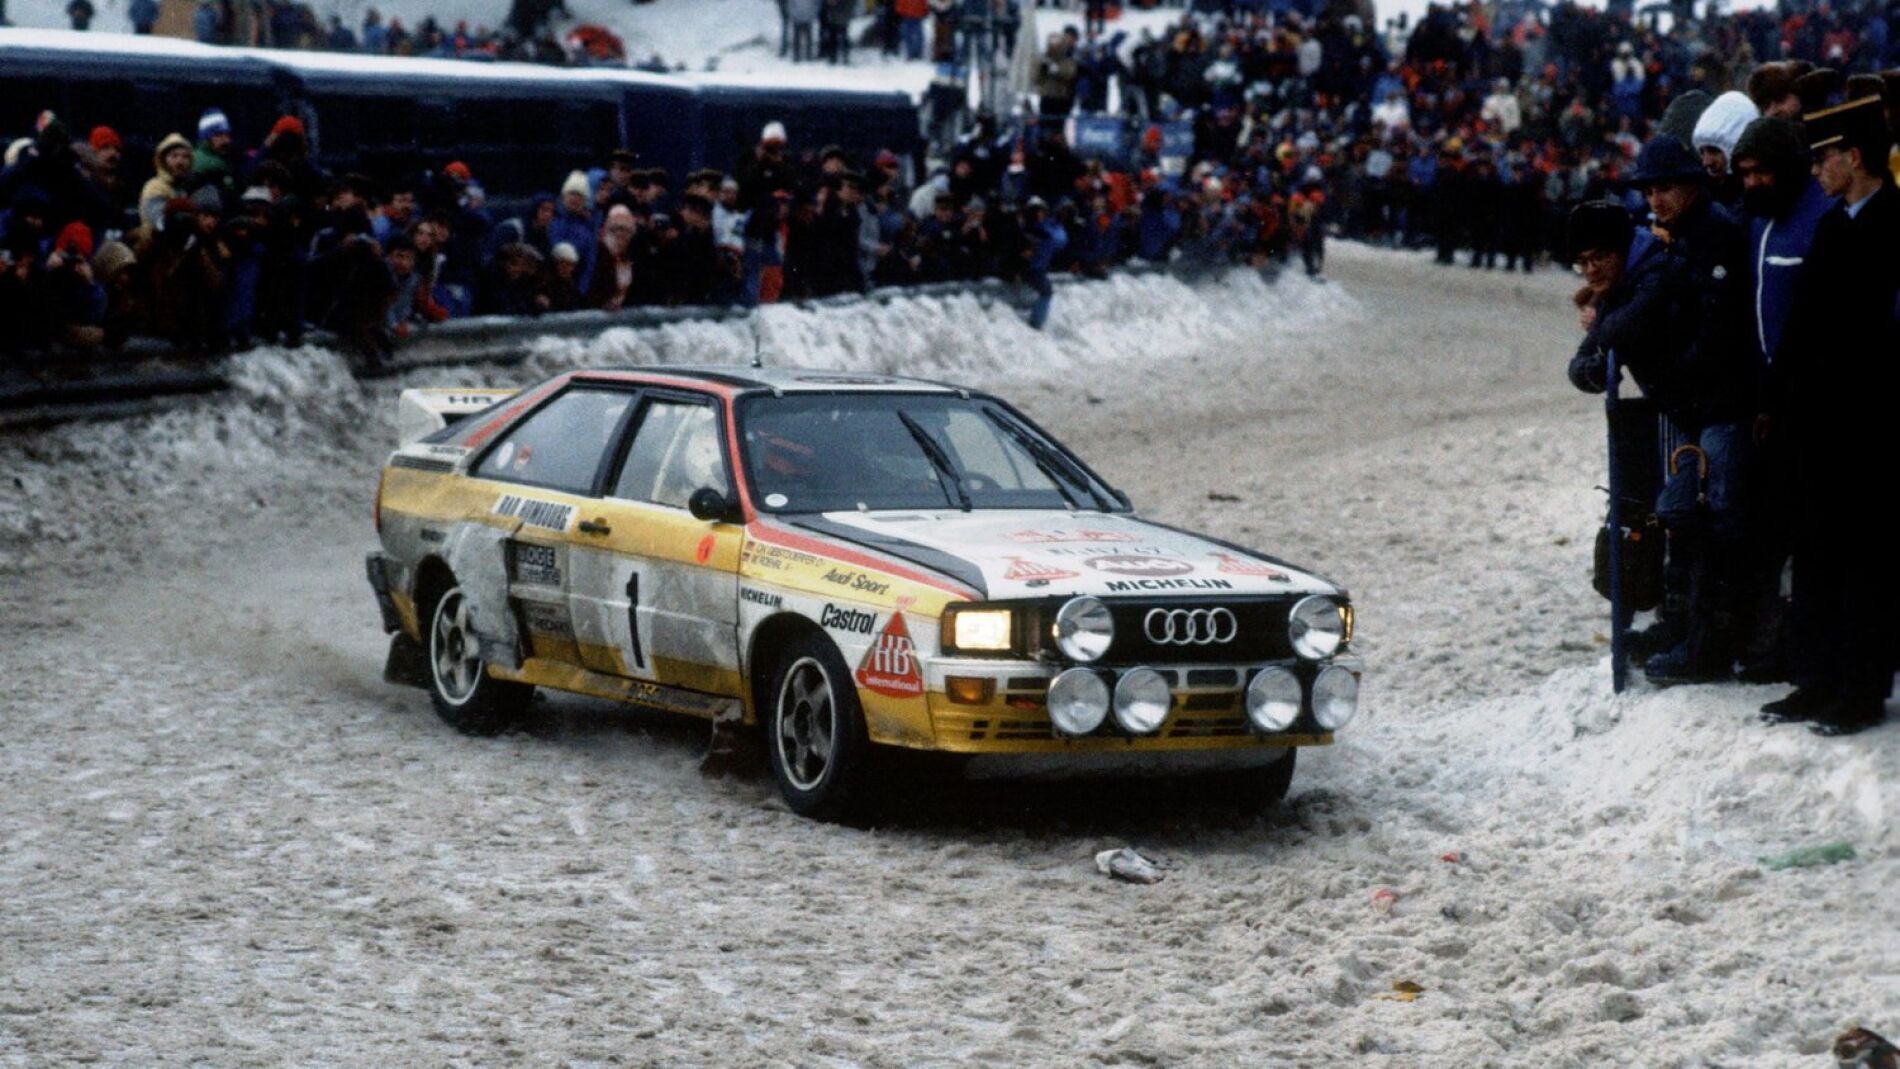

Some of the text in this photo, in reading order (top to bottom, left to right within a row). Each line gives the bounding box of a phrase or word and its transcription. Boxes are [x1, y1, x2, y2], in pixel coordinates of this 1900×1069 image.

[821, 567, 890, 596] Audi Sport
[1106, 579, 1233, 592] MICHELIN
[625, 571, 646, 669] 1
[821, 602, 878, 634] Castrol
[874, 633, 913, 677] HB
